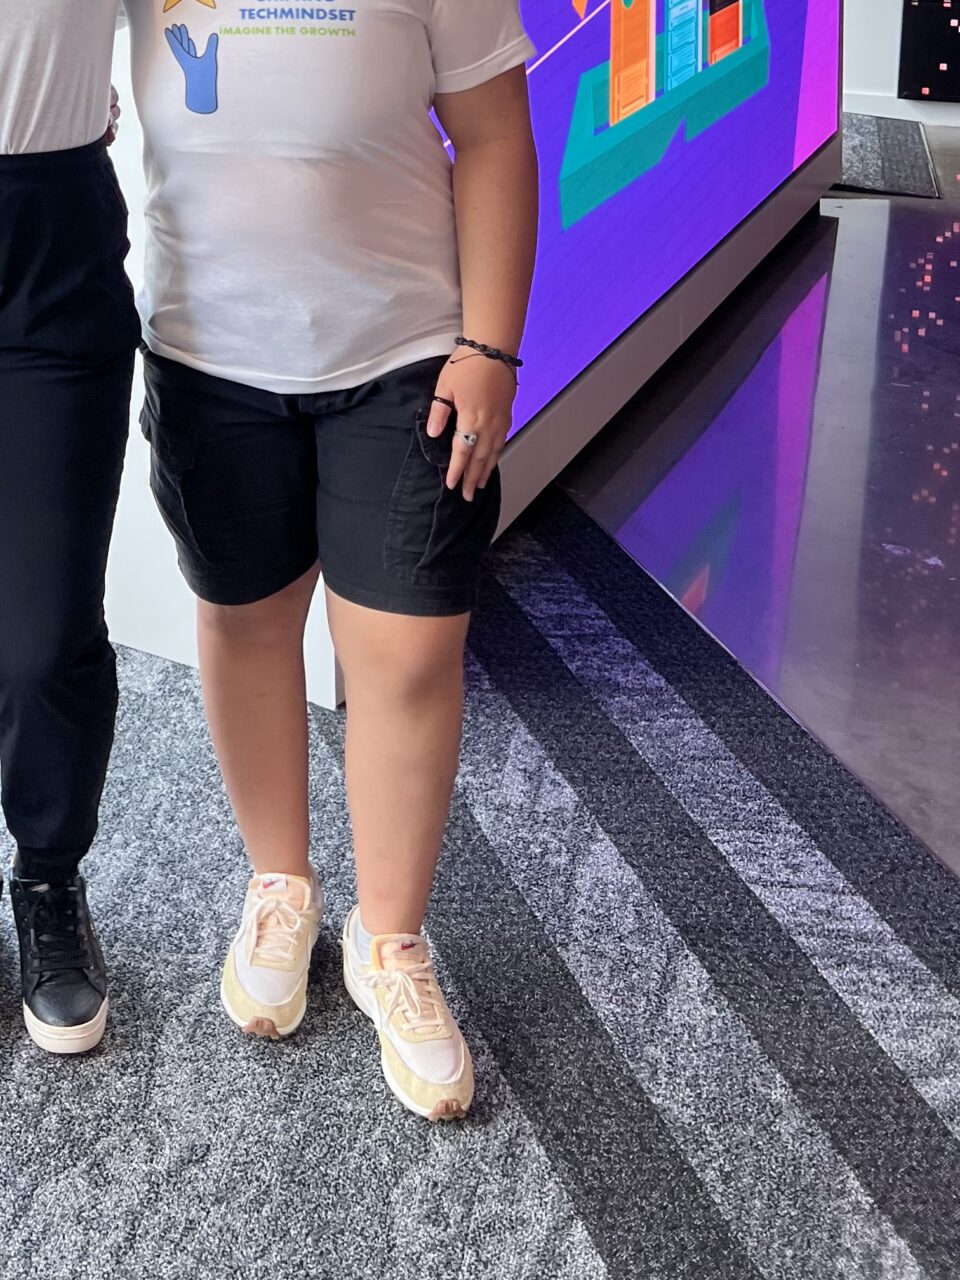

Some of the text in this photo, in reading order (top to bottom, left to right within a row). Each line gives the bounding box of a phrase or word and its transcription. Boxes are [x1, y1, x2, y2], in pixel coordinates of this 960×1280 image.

[239, 8, 356, 21] TECHMINDSET
[219, 26, 356, 37] IMAGINE THE GROWTH
